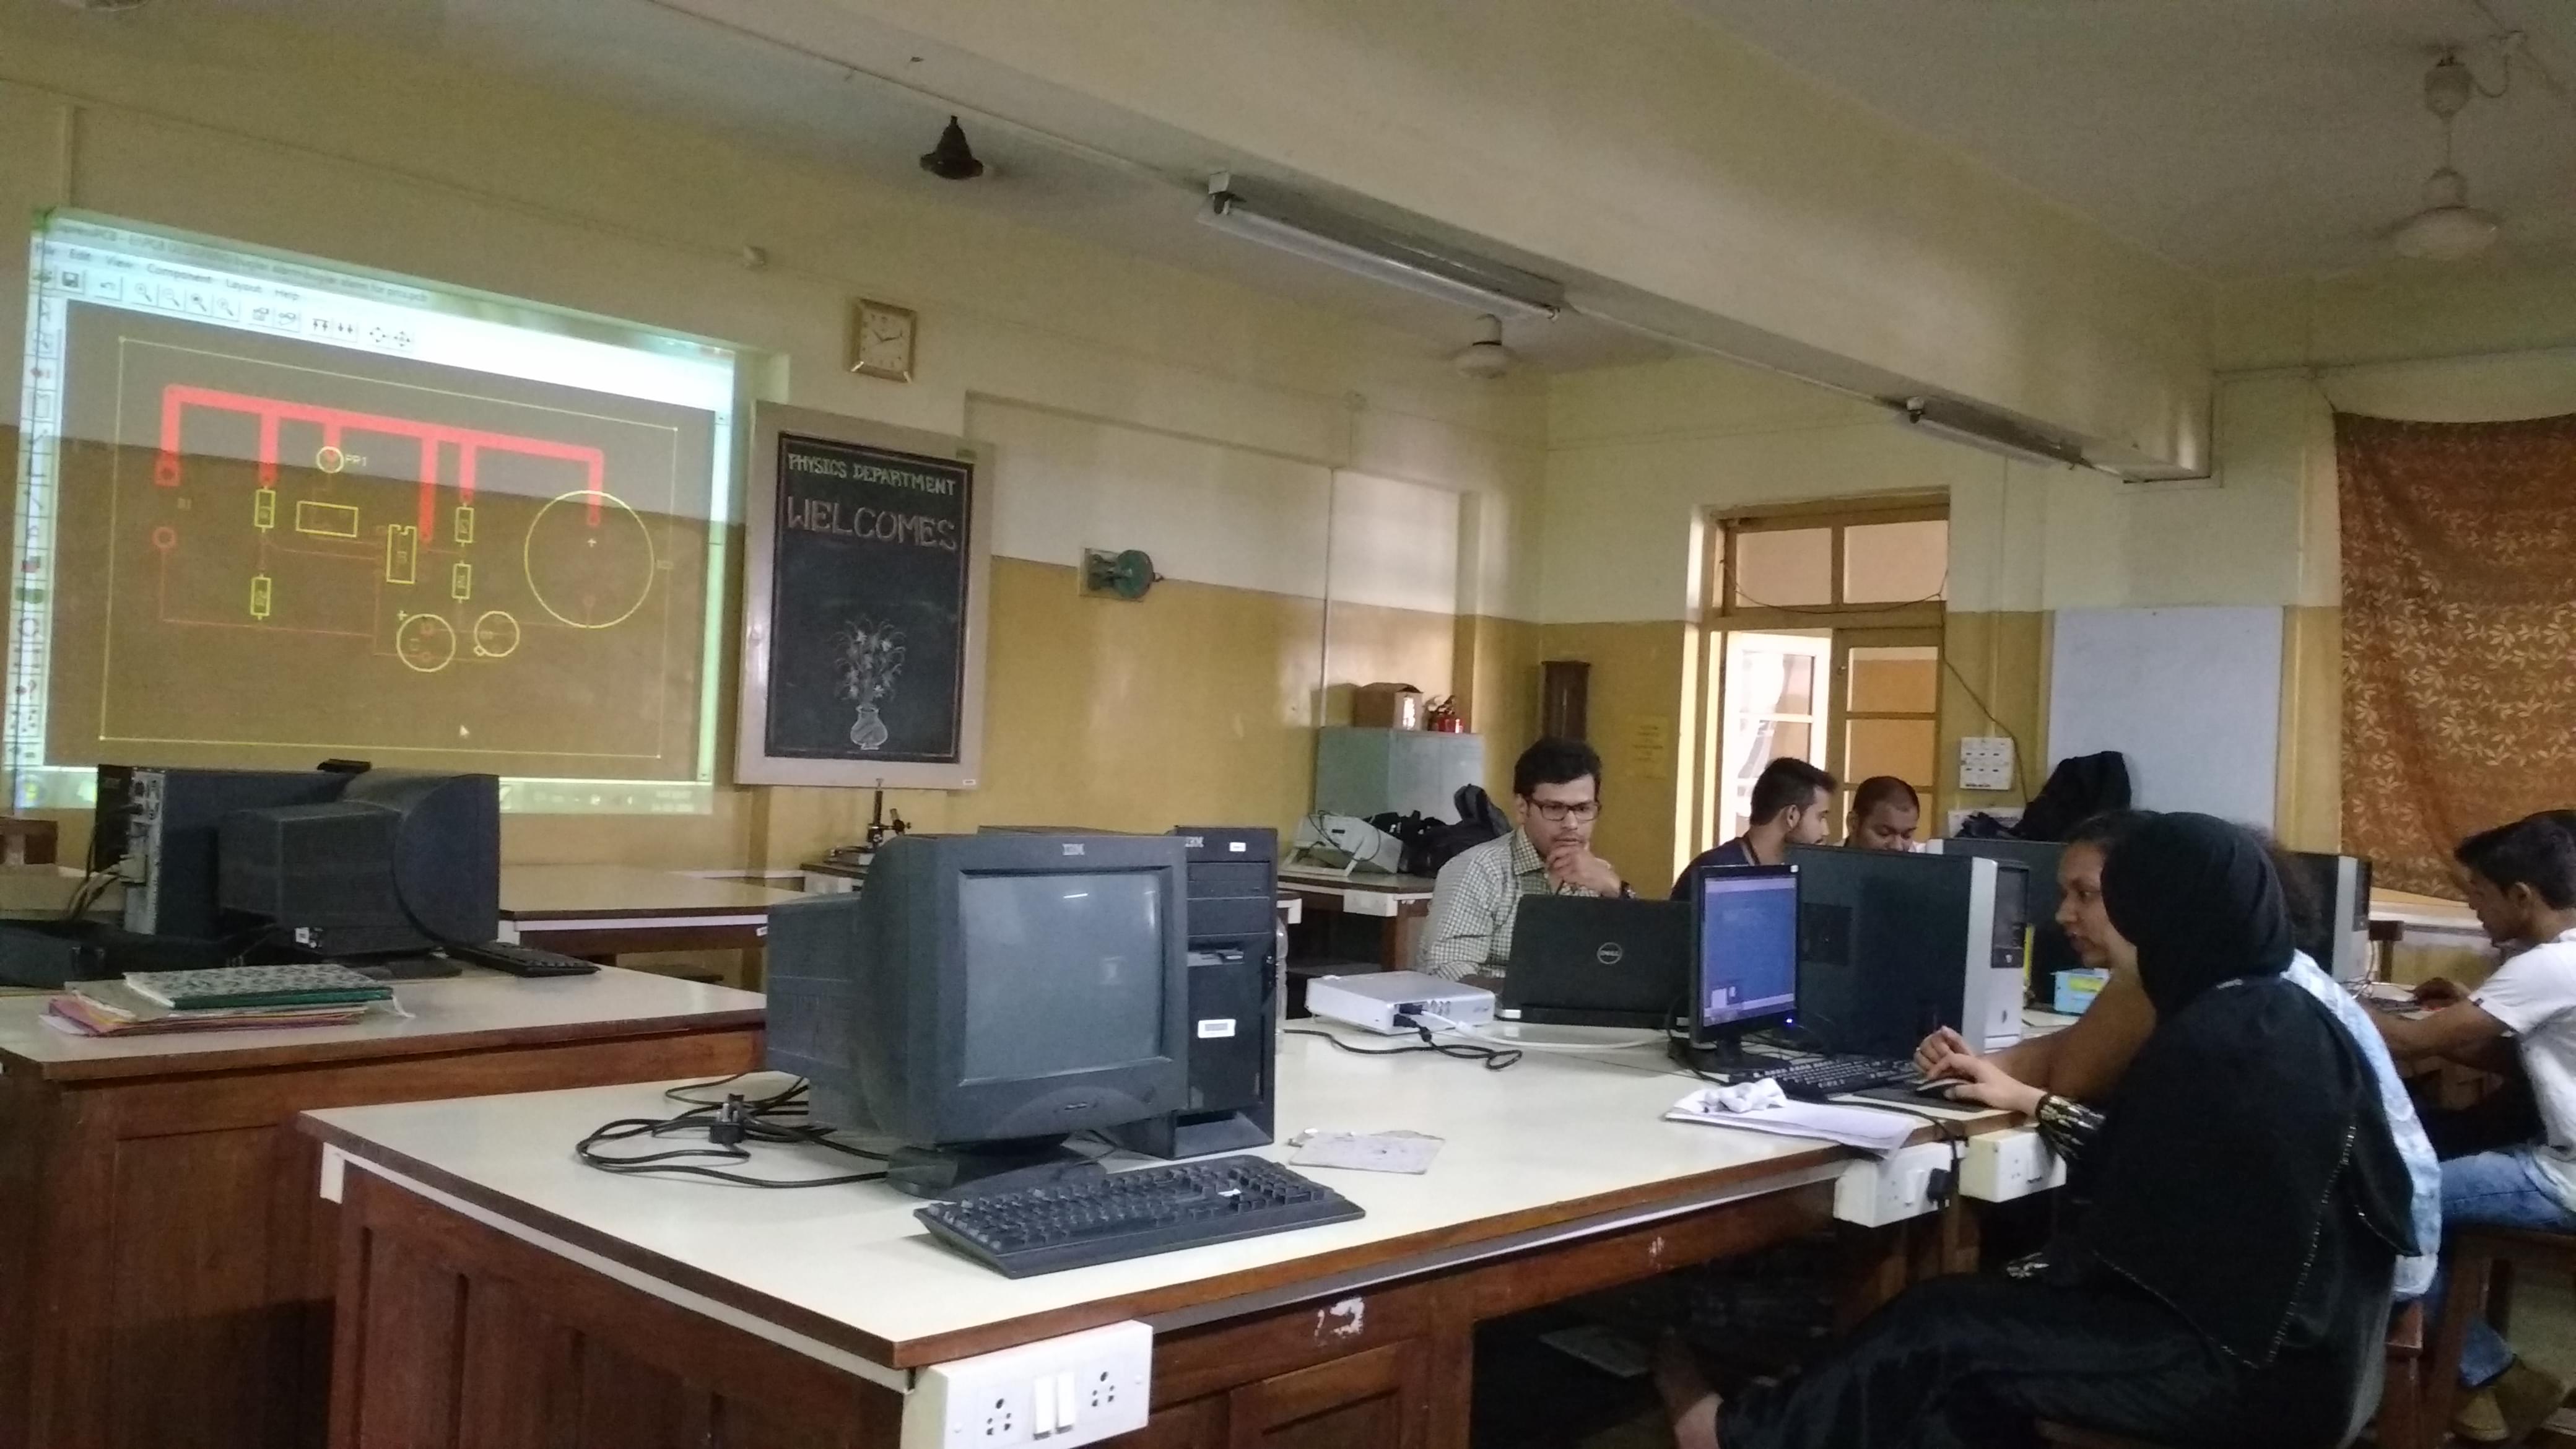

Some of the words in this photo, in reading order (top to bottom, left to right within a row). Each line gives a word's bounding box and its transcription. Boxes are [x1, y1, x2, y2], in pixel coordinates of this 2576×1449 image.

[147, 263, 212, 283] Component
[227, 279, 262, 294] Layout
[275, 289, 300, 301] Help
[788, 453, 847, 478] PHYSICS
[853, 463, 956, 496] DEPARTMENT
[788, 496, 956, 551] WELCOMES
[1062, 843, 1085, 855] IBM
